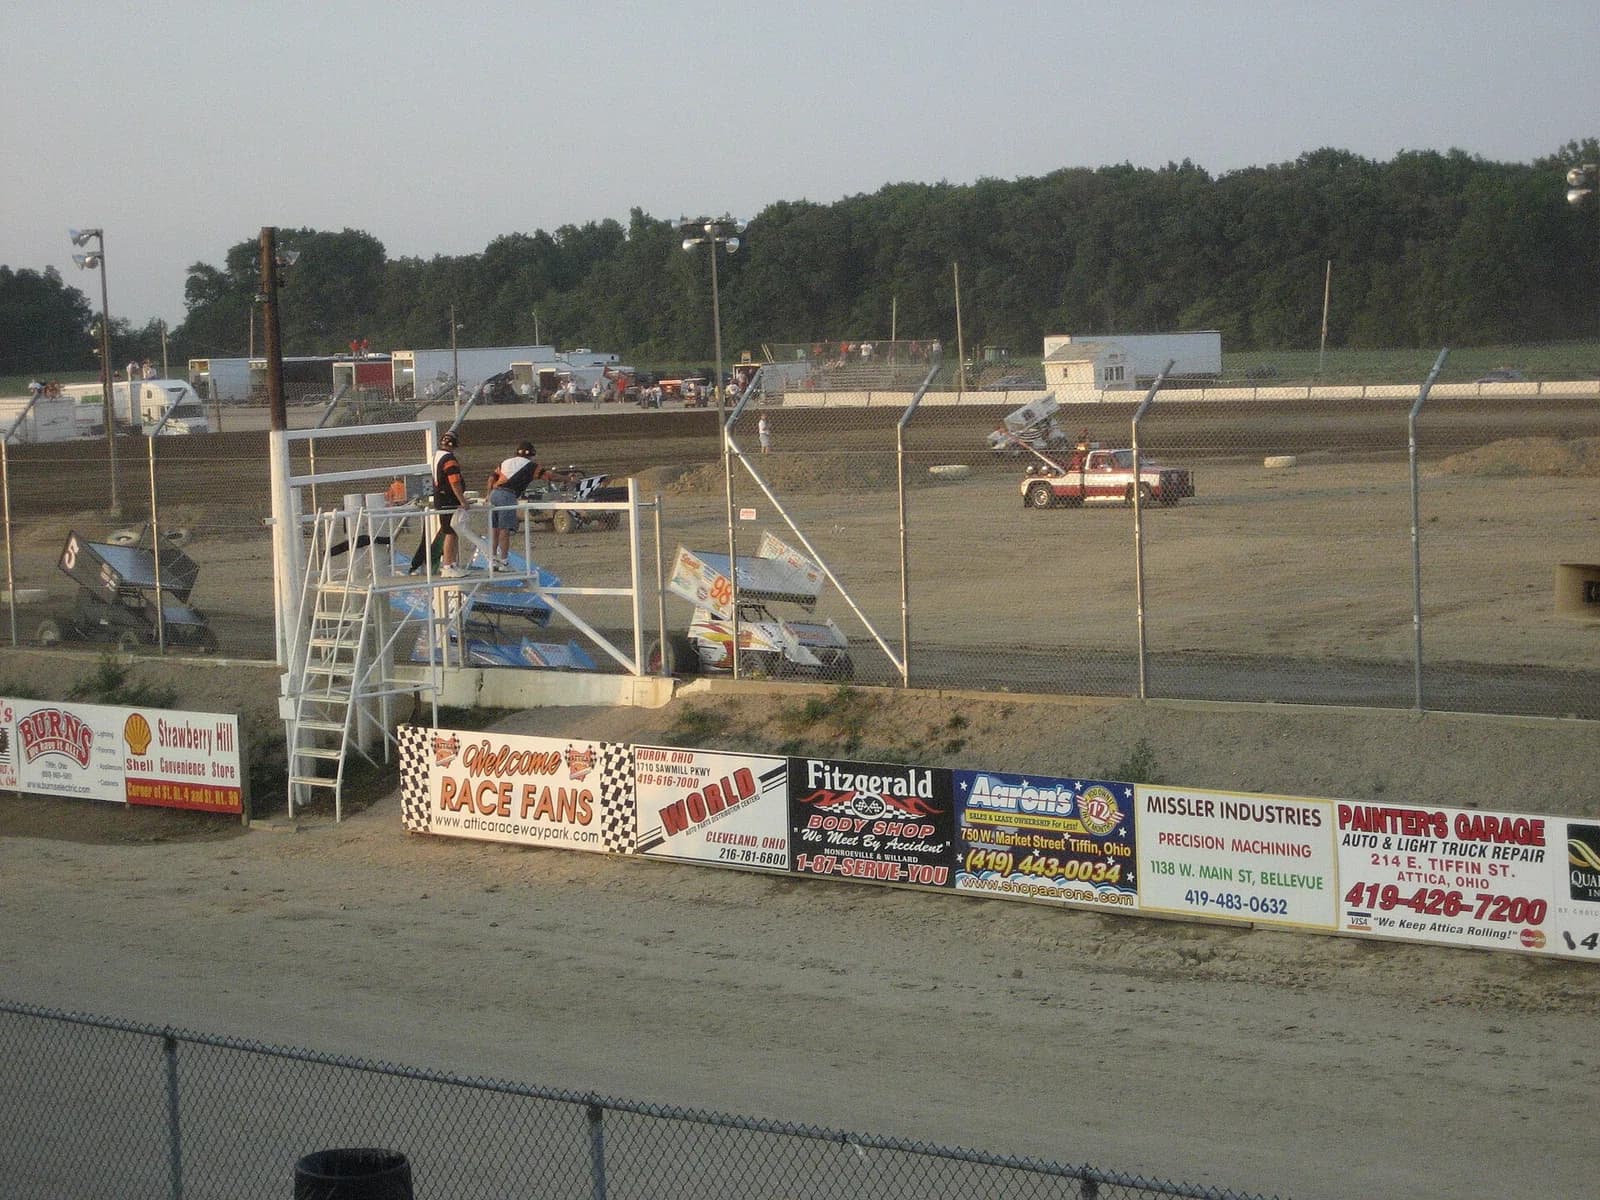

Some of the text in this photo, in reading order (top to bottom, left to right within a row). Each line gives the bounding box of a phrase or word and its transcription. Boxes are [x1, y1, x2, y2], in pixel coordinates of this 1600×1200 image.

[18, 709, 94, 769] BURNS
[158, 718, 233, 756] Strawberry Hill
[126, 757, 235, 779] Shell Convenience Store
[463, 739, 562, 778] Welcome
[636, 763, 711, 777] 1710 SAWMILL PKWY
[671, 752, 694, 764] OHIO
[637, 773, 699, 788] 419-616-7000
[807, 760, 933, 799] Fitzgerald
[440, 776, 594, 826] RACE FANS
[658, 767, 756, 837] WORLD
[967, 774, 1074, 816] Aaron's
[994, 814, 1013, 823] LEASE
[1014, 816, 1051, 827] OWNERSHIP
[1052, 819, 1062, 827] For
[1063, 821, 1079, 830] Less!
[1088, 800, 1110, 820] 12
[1147, 795, 1322, 827] MISSLER INDUSTRIES
[435, 815, 599, 843] www.atticaracewaypark.com
[808, 815, 936, 839] BODY SHOP
[1338, 804, 1546, 846] PAINTER'S GARAGE
[706, 831, 786, 850] CLEVELAND, OHIO
[827, 830, 859, 845] Meet
[862, 835, 882, 850] By
[961, 828, 1131, 857] 750 W. Market Street Tiffin, Ohio
[1159, 832, 1312, 858] PRECISION MACHINING
[1342, 833, 1545, 863] AUTO & LIGHT TRUCK REPAIR
[720, 848, 786, 866] 216-781-6800
[824, 848, 874, 859] MONROEVILLE
[884, 854, 918, 863] WILLARD
[965, 849, 1121, 884] (419) 443-0034
[1371, 854, 1516, 878] 214 E. TIFFIN ST.
[796, 853, 949, 885] 1-87-SERVE-YOU
[1150, 860, 1324, 890] 1138 W. MAIN ST, BELLEVUE
[1397, 871, 1490, 889] ATTICA, OHIO
[961, 876, 1134, 905] www.shopaarons.com
[1185, 889, 1288, 915] 419-483-0632
[1344, 881, 1548, 925] 419-426-7200
[1350, 917, 1368, 926] VISA
[1399, 919, 1426, 932] Keep
[1429, 921, 1464, 935] Attica
[1467, 926, 1518, 940] Rolling!"
[1580, 932, 1599, 950] 4
